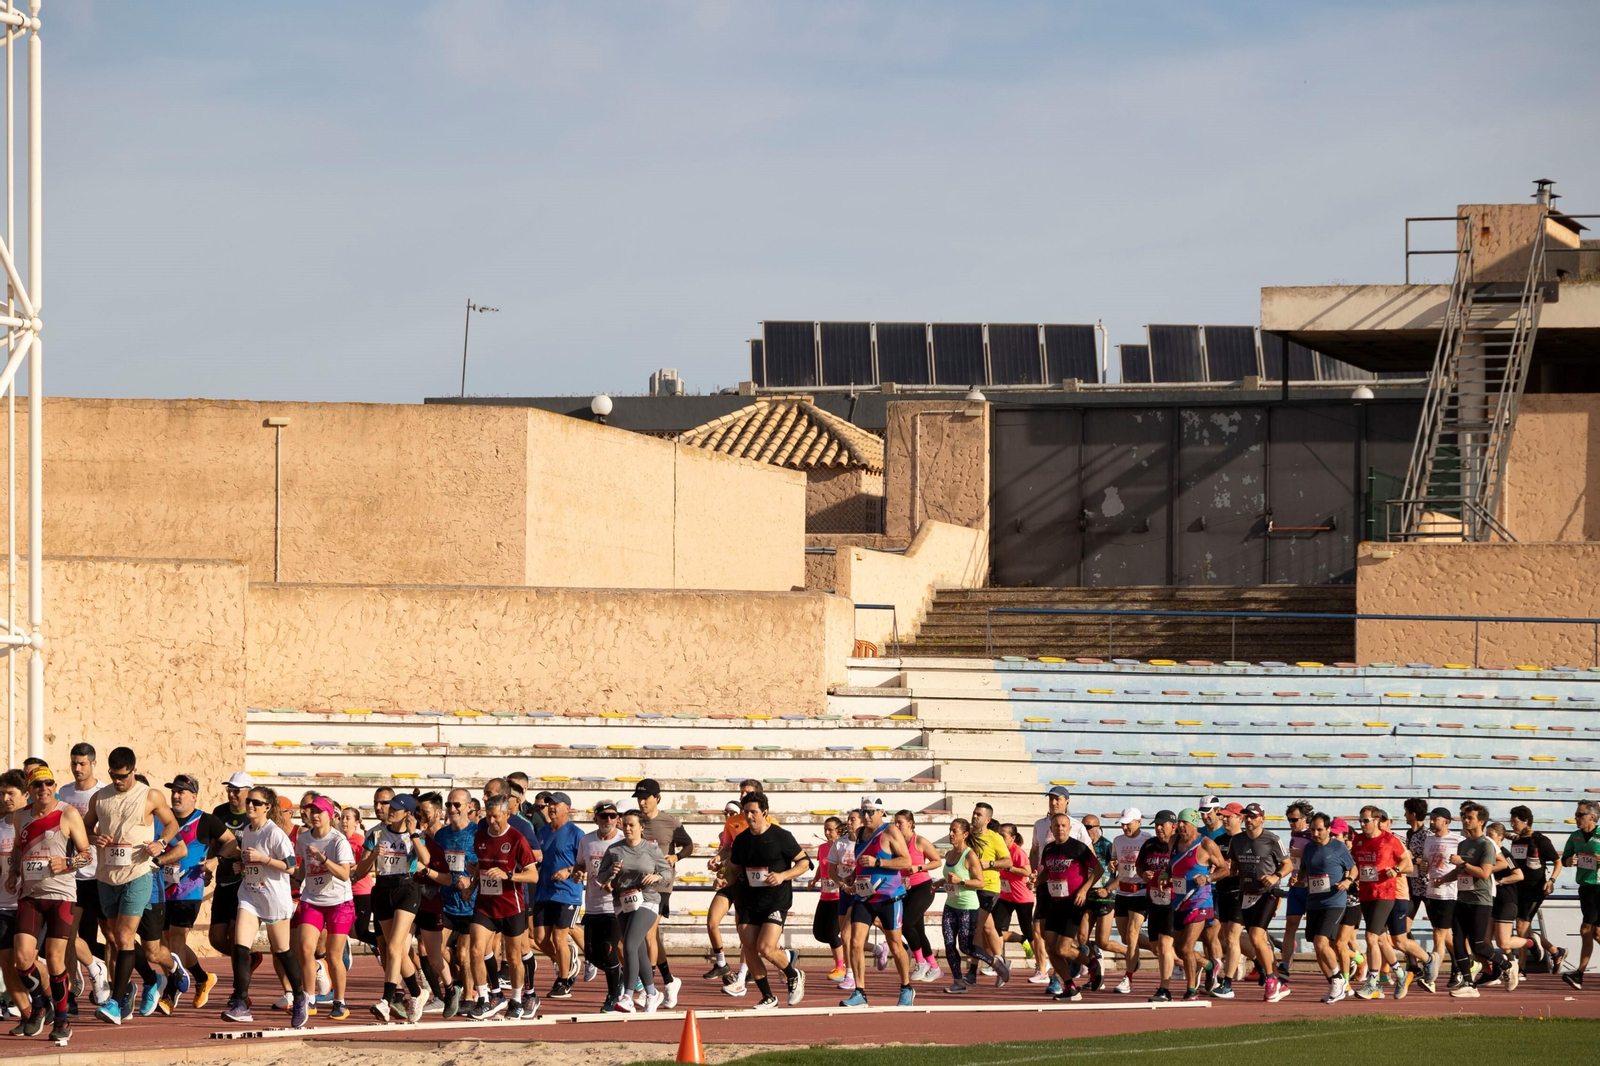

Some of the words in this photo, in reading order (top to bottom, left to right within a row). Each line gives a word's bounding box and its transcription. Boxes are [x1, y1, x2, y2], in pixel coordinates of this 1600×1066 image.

[110, 848, 125, 857] 348
[384, 856, 400, 865] 707
[26, 861, 43, 871] 273
[162, 867, 174, 875] 50
[313, 877, 324, 885] 32
[482, 879, 498, 887] 762
[1312, 879, 1325, 887] 613
[624, 894, 638, 905] 440
